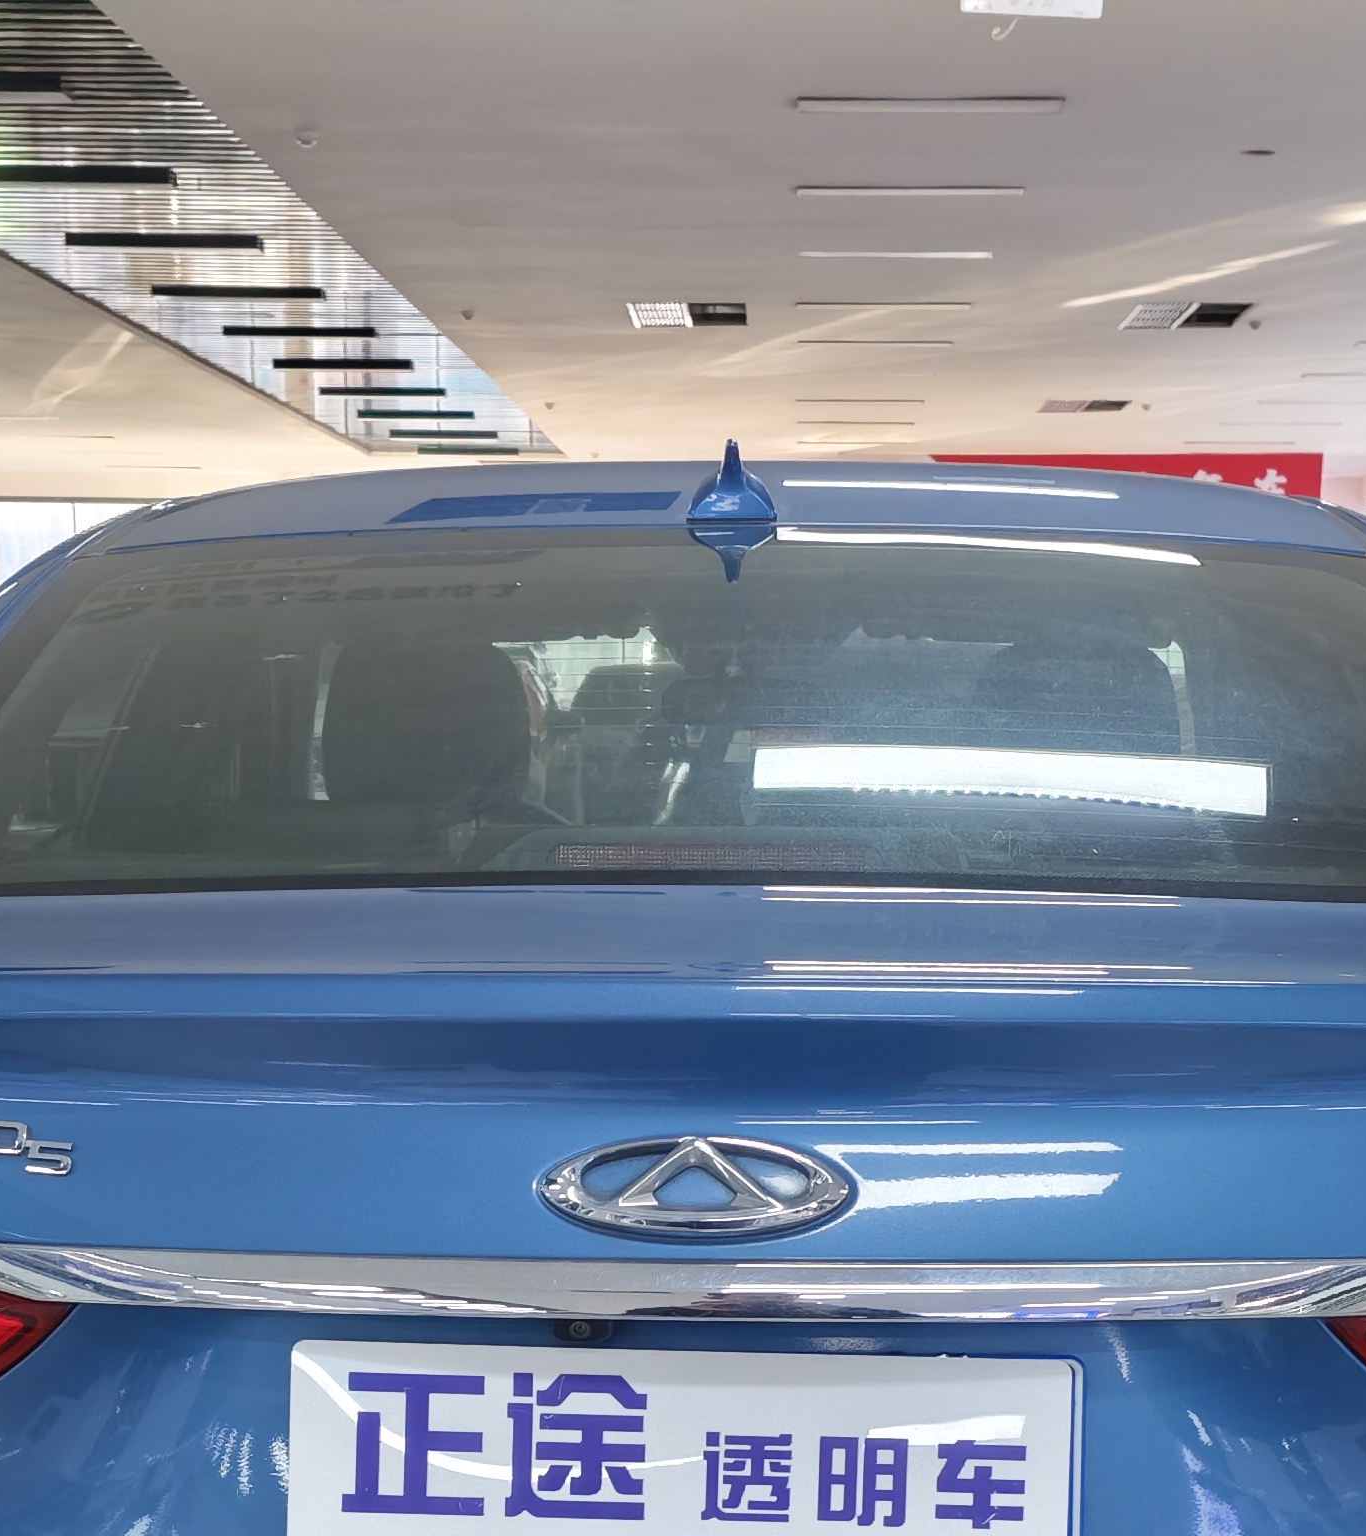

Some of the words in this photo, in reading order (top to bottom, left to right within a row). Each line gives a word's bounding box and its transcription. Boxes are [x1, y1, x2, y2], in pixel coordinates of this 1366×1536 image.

[340, 1371, 648, 1521] 正途
[702, 1430, 1029, 1530] 透明车
